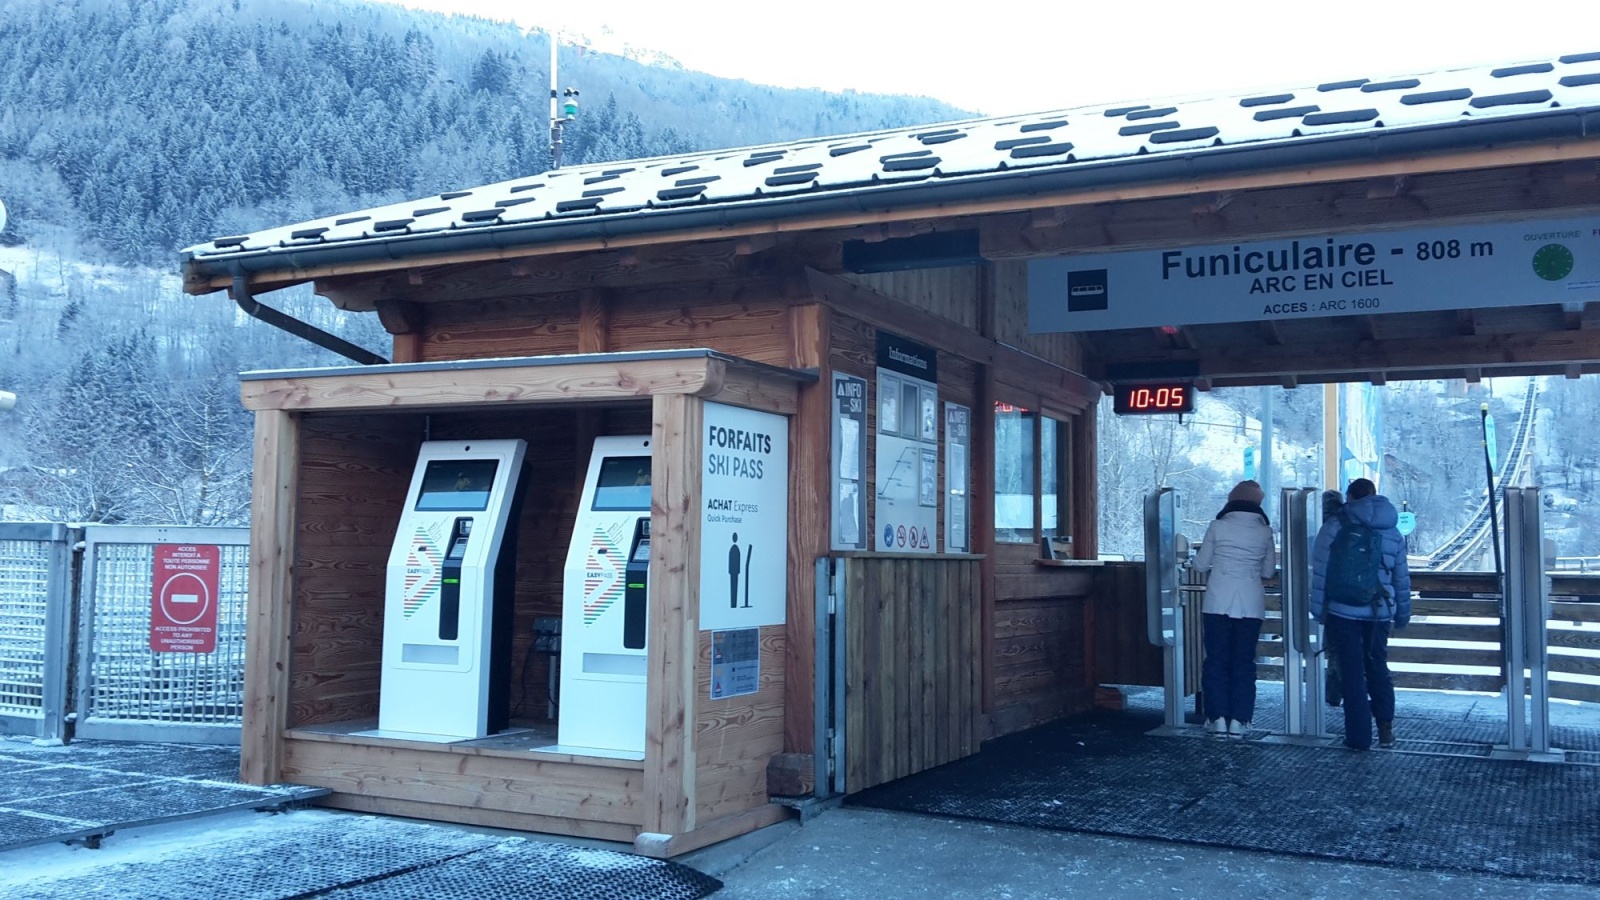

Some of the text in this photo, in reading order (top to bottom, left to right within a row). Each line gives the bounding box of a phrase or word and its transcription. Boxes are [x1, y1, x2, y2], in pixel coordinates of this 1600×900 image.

[1523, 230, 1581, 242] OUVERTURE
[1161, 237, 1376, 280] Funiculaire
[1416, 238, 1461, 261] 808
[1470, 240, 1494, 257] m
[1249, 269, 1394, 295] ARC EN CIEL
[1263, 302, 1308, 315] ACCES
[1318, 299, 1347, 312] ARC
[1351, 297, 1380, 309] 1600
[888, 345, 928, 370] Informations
[845, 382, 862, 398] INFO
[709, 425, 772, 455] FORFAITS
[708, 453, 764, 480] SKI PASS
[707, 498, 759, 515] ACHAT Express
[707, 513, 742, 524] Quick Purchase
